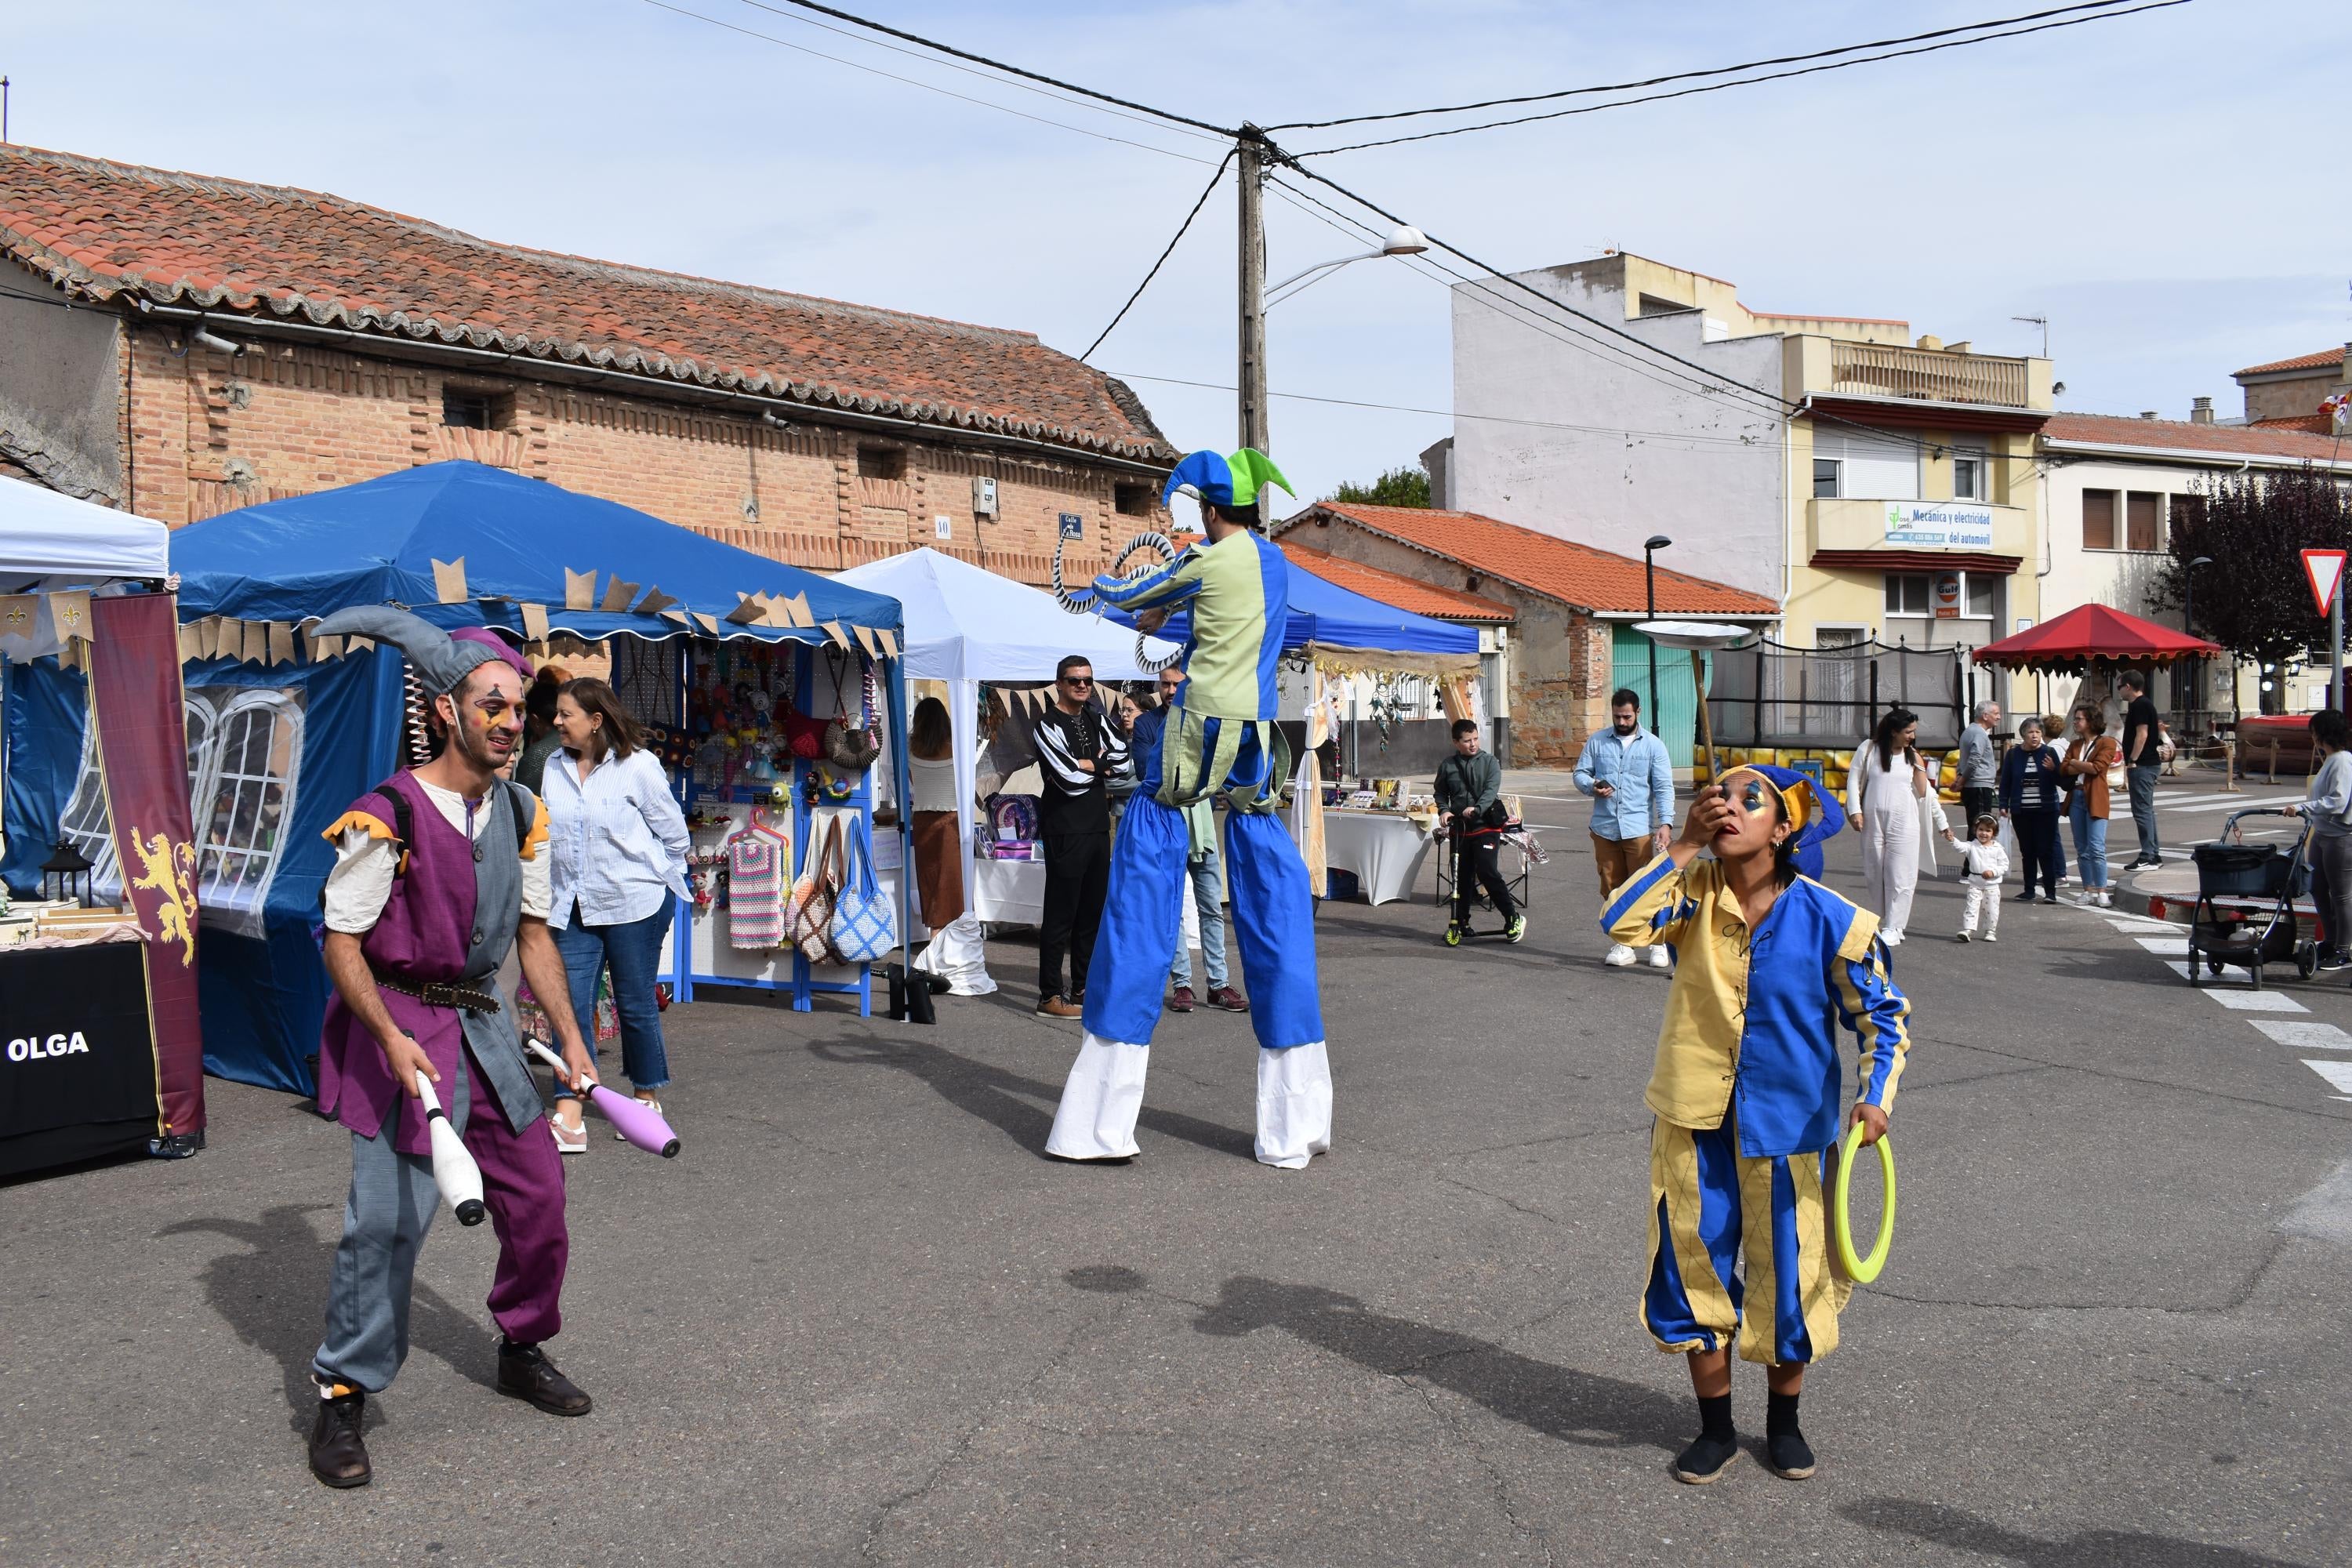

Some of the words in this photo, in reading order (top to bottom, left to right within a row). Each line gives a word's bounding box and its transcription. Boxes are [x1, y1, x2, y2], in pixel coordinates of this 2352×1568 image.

[1913, 509, 1947, 522] Mecánica
[1948, 513, 1953, 524] y
[1954, 511, 1990, 525] electricidad
[938, 521, 948, 533] 10
[1949, 532, 1959, 543] del
[1961, 532, 1990, 545] automóvil
[1938, 585, 1958, 593] Gulf
[8, 1031, 89, 1062] OLGA
